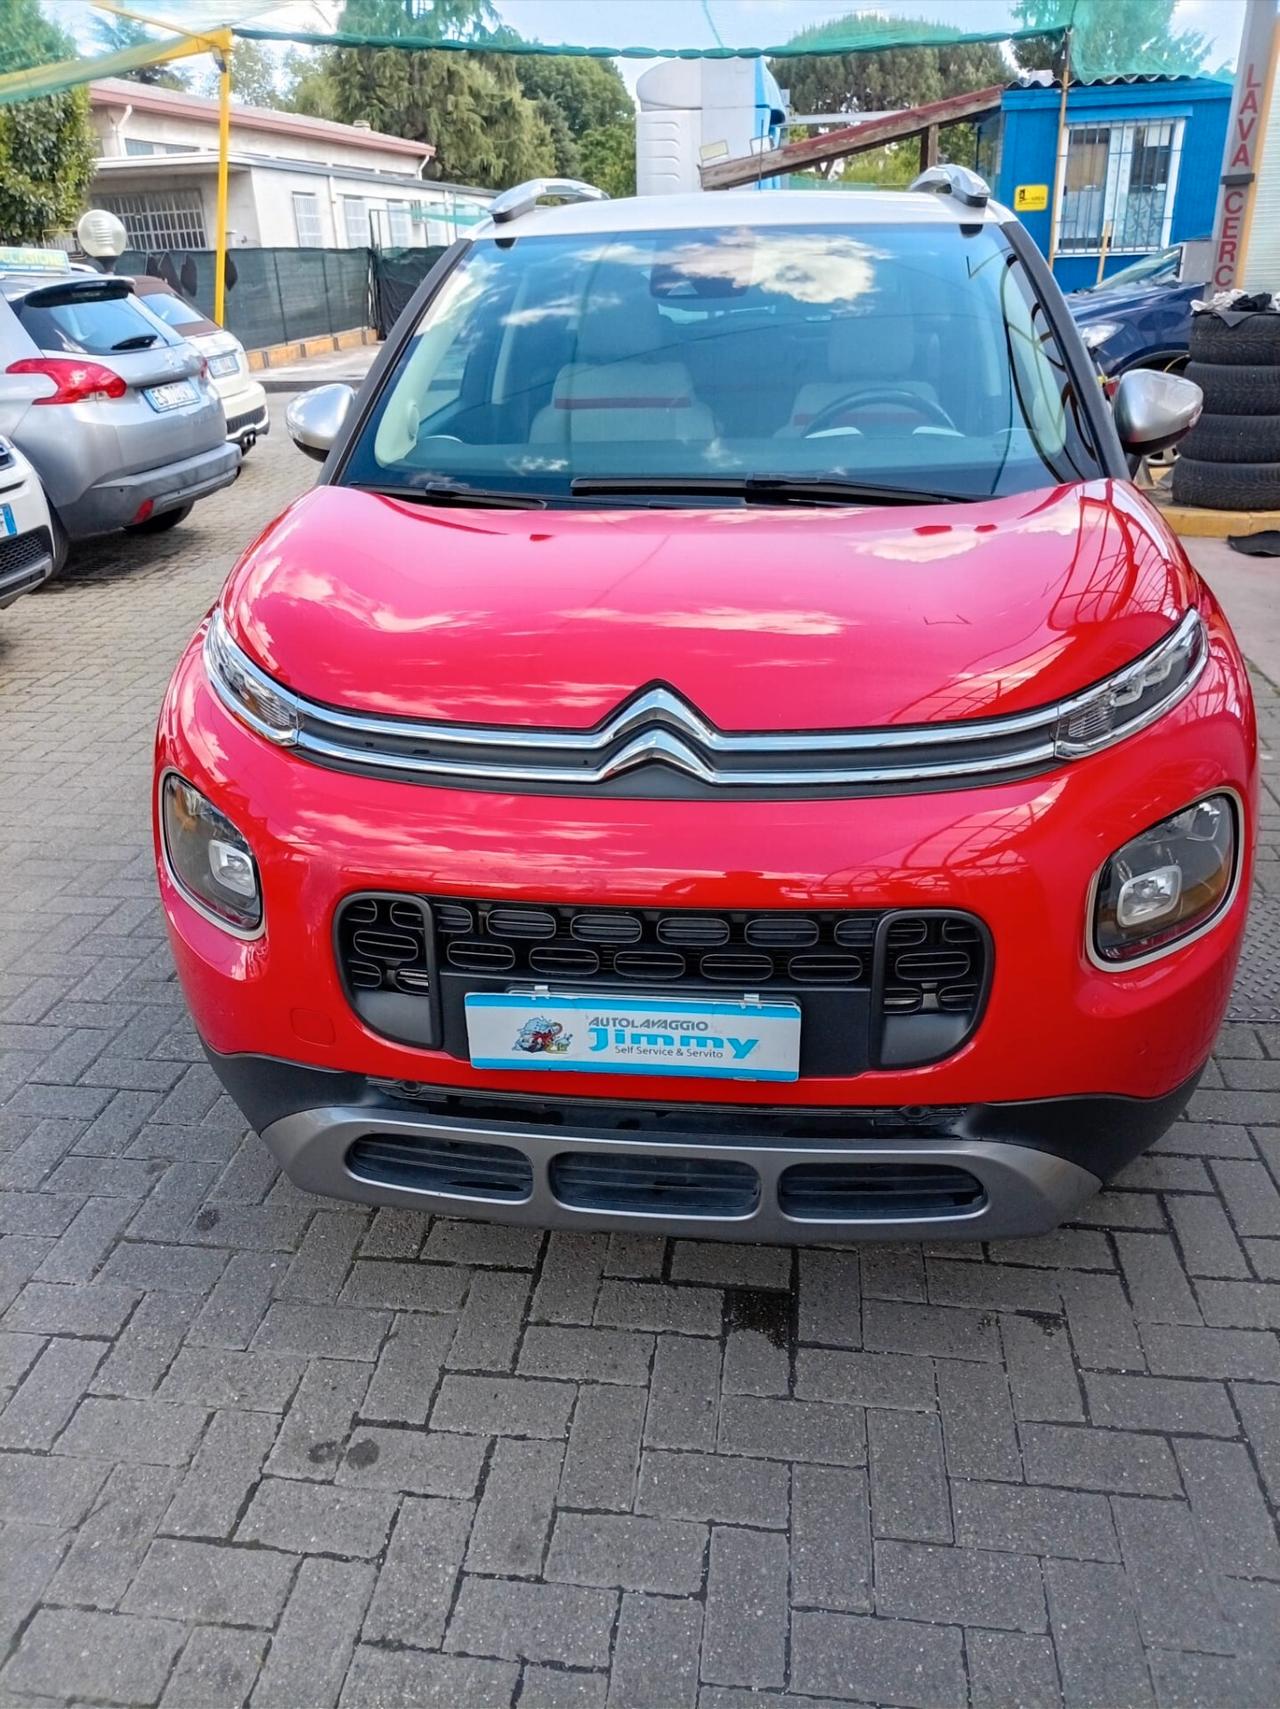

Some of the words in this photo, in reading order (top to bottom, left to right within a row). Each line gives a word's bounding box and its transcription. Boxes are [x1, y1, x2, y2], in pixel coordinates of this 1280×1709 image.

[1231, 63, 1261, 167] LAVA
[1213, 191, 1244, 294] CERC
[588, 1016, 709, 1032] AUTOLAVAGGIO
[587, 1027, 760, 1060] Jimmy
[615, 1046, 634, 1055] Self
[636, 1046, 675, 1057] Service
[675, 1048, 684, 1057] &
[686, 1048, 724, 1059] Servito
